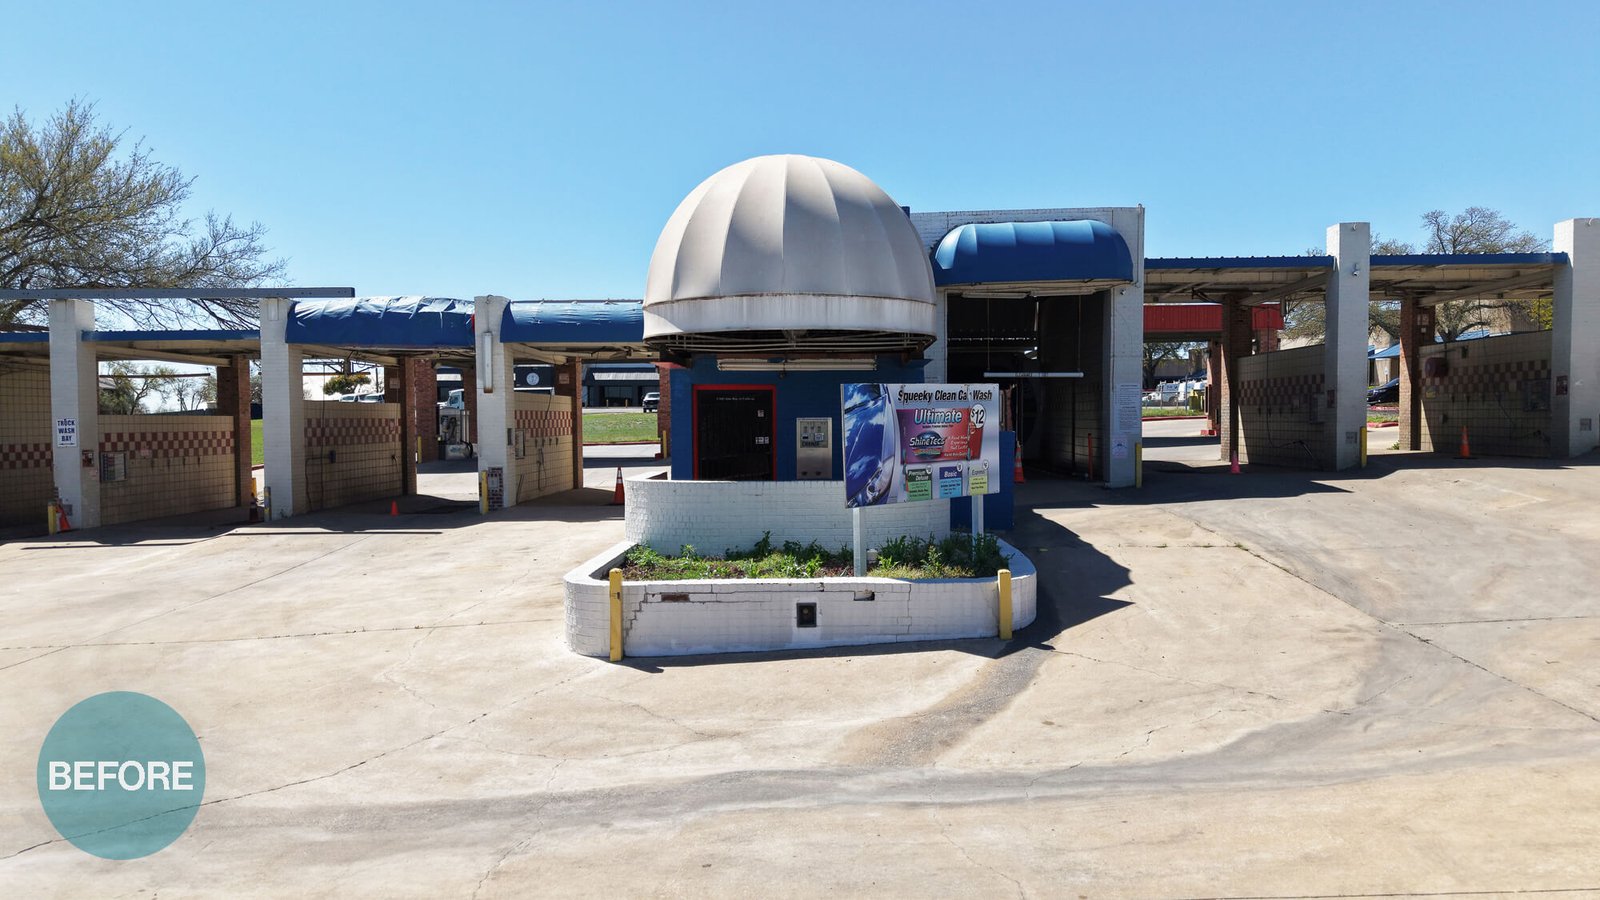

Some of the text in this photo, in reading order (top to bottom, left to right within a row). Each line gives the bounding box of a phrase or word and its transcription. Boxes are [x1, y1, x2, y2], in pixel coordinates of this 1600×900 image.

[898, 390, 993, 403] Squeeky Clean Ca Wash
[914, 408, 963, 424] Ultimate
[971, 409, 985, 424] $12
